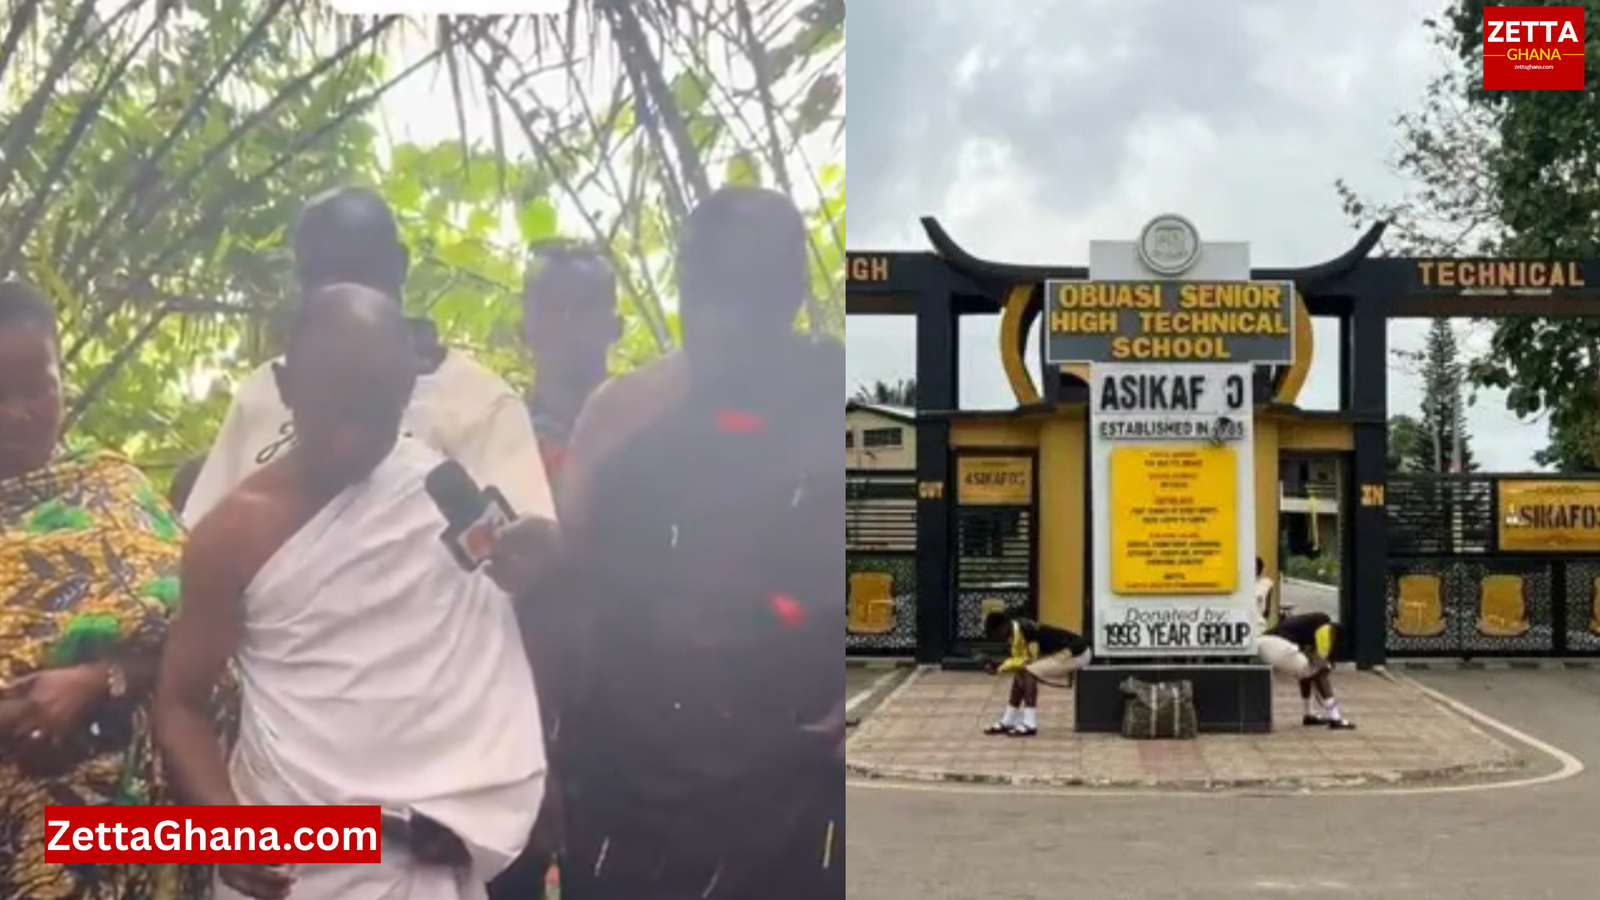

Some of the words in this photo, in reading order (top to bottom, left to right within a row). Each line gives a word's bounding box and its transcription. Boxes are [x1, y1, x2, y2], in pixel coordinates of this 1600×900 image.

[1418, 261, 1585, 286] TECHNICAL
[1059, 284, 1162, 308] OBUASI
[1180, 284, 1282, 308] SENIOR
[1051, 311, 1118, 332] HIGH
[1140, 311, 1288, 333] TECHNICAL
[1112, 337, 1231, 358] SCHOOL
[1101, 421, 1193, 436] ESTABLISHED
[1196, 421, 1208, 436] IN
[1126, 607, 1200, 623] Donated
[1105, 622, 1141, 645] 1993
[1147, 622, 1191, 645] YEAR
[1197, 622, 1250, 645] GROUP
